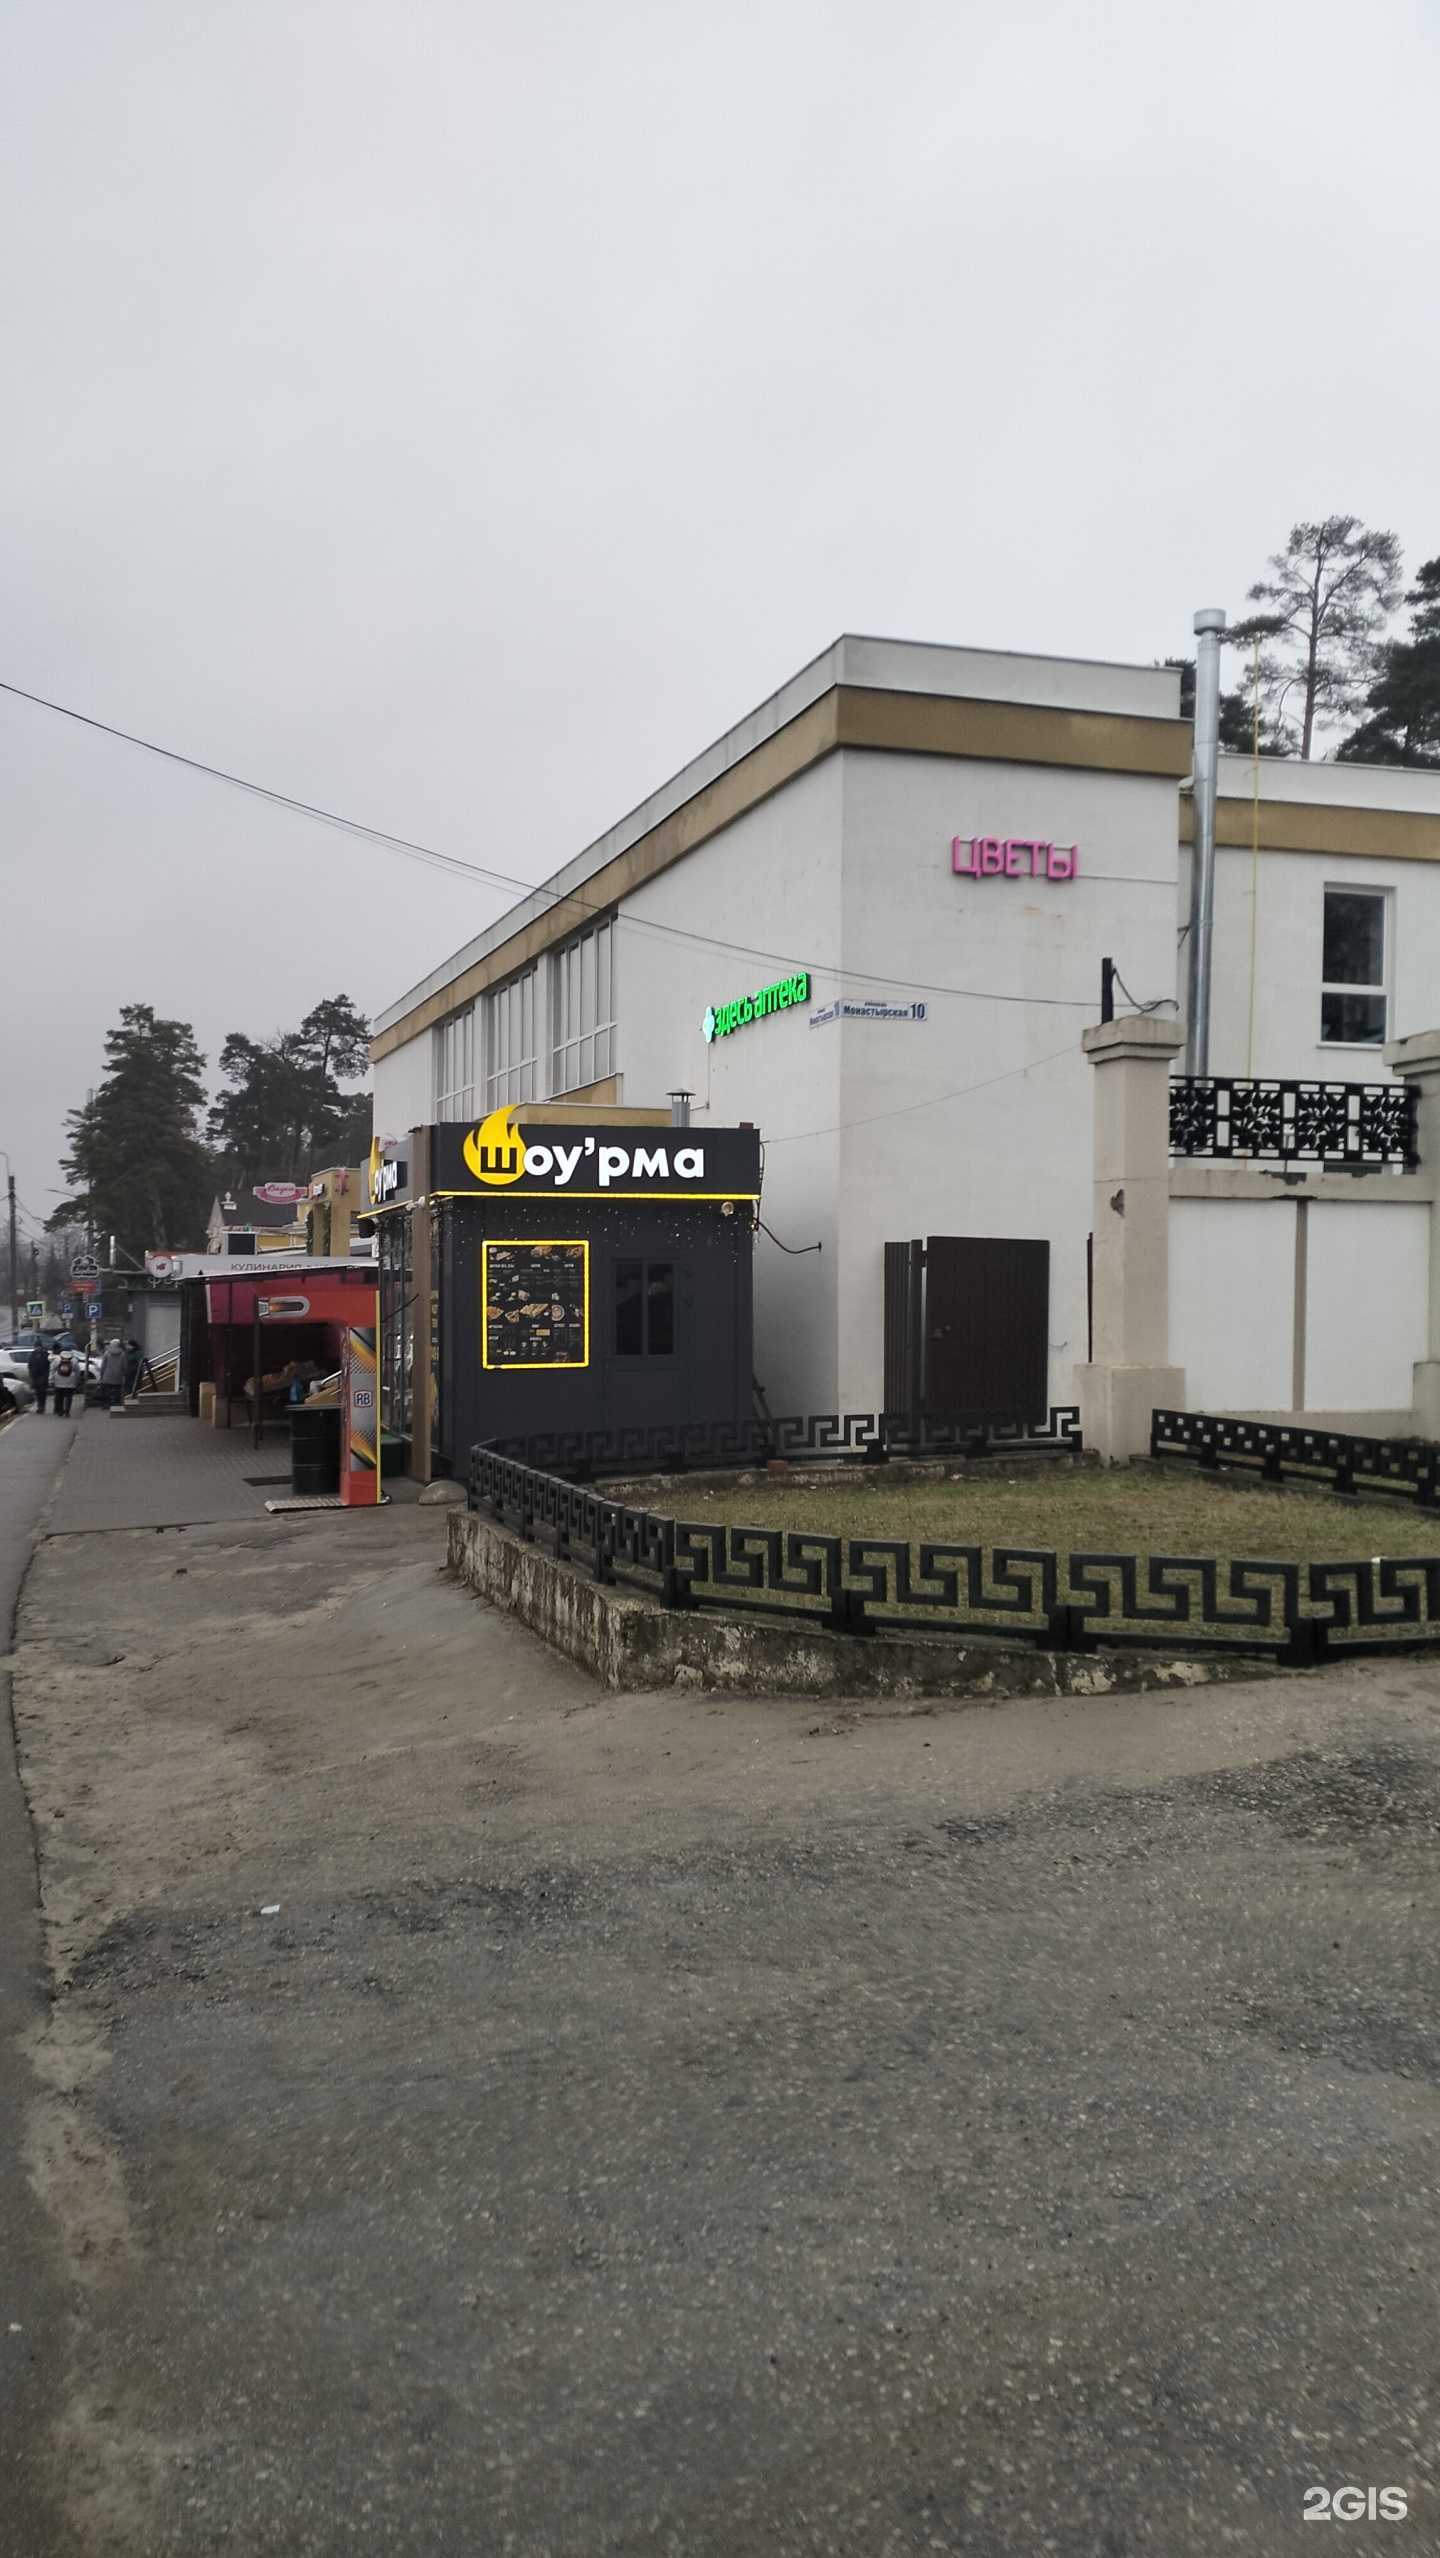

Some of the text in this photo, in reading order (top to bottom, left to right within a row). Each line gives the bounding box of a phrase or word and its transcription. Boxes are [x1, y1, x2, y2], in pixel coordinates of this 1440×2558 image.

[951, 835, 1078, 880] ЦВЕТЫ
[714, 972, 809, 1037] здесь аптека
[843, 1005, 908, 1019] Монастырская
[911, 1003, 925, 1019] 10
[480, 1137, 705, 1187] шоу'рма
[88, 1305, 98, 1316] P
[357, 1393, 370, 1405] RB
